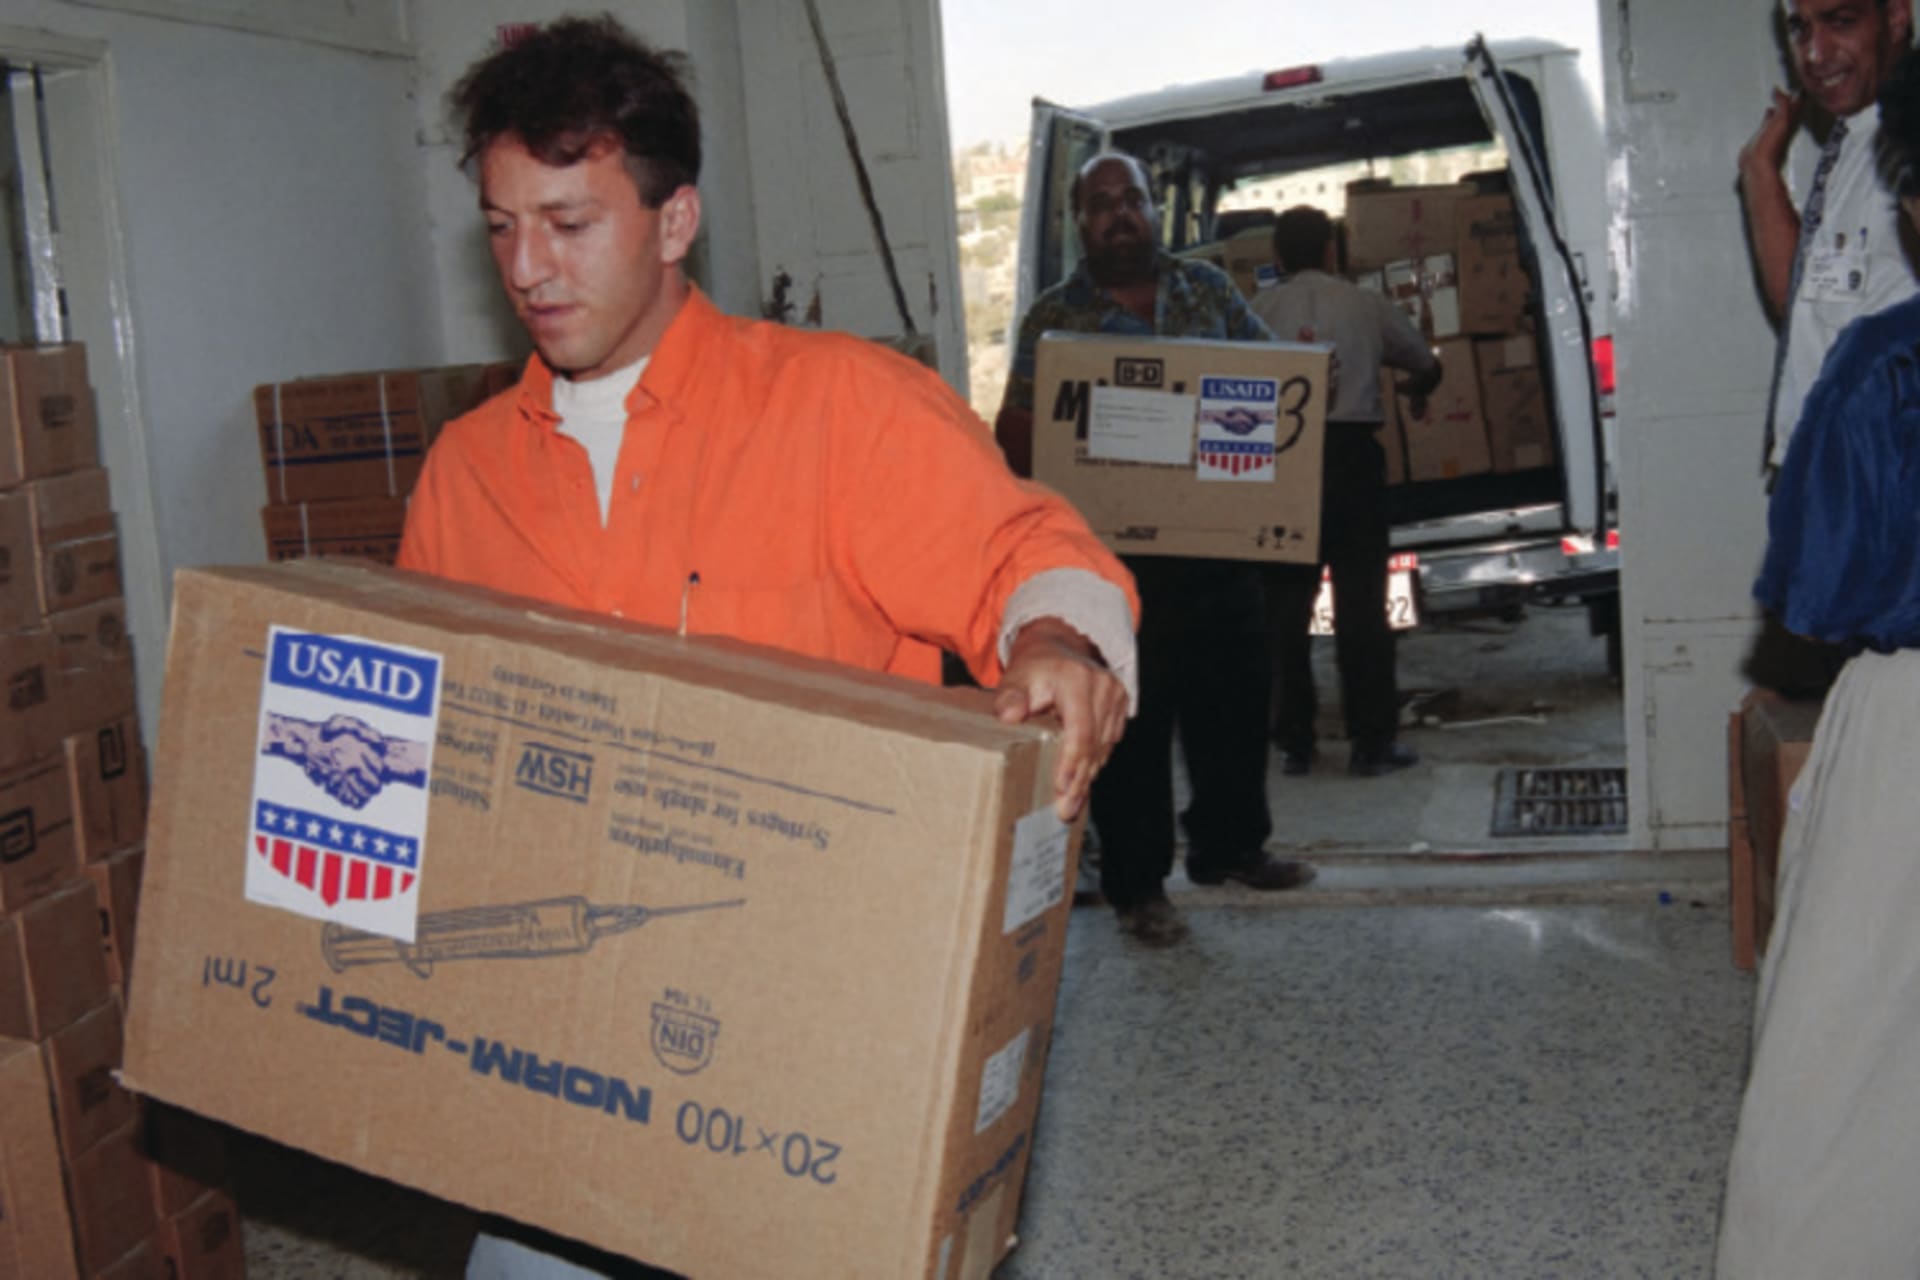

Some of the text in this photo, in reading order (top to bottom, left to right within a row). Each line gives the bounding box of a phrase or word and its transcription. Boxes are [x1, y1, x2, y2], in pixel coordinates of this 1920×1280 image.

[1208, 380, 1272, 398] USAID
[287, 641, 422, 701] USAID
[516, 750, 592, 796] HSW
[302, 987, 652, 1125] NORM-JECT
[660, 1023, 704, 1056] DIN
